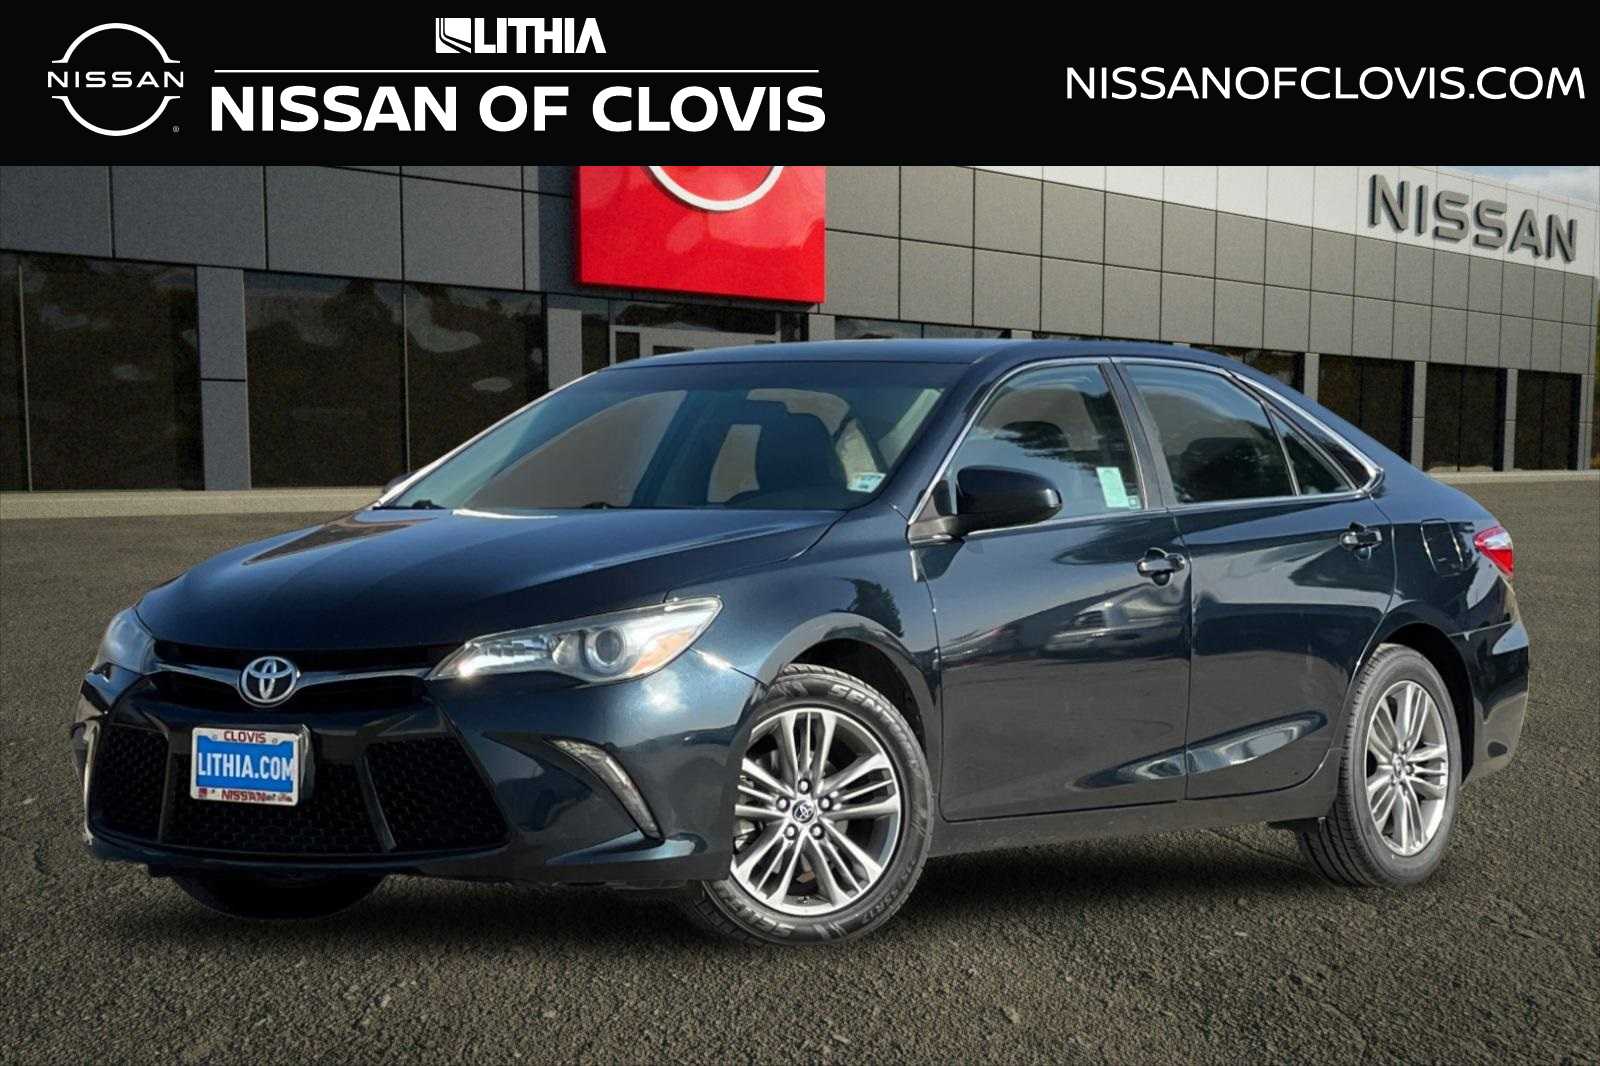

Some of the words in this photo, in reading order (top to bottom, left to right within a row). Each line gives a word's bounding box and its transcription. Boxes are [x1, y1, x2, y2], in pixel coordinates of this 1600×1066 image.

[1368, 173, 1577, 263] NISSAN
[223, 730, 266, 744] CLOVIS
[197, 751, 294, 781] LITHIA.COM
[221, 789, 267, 802] NISSAN
